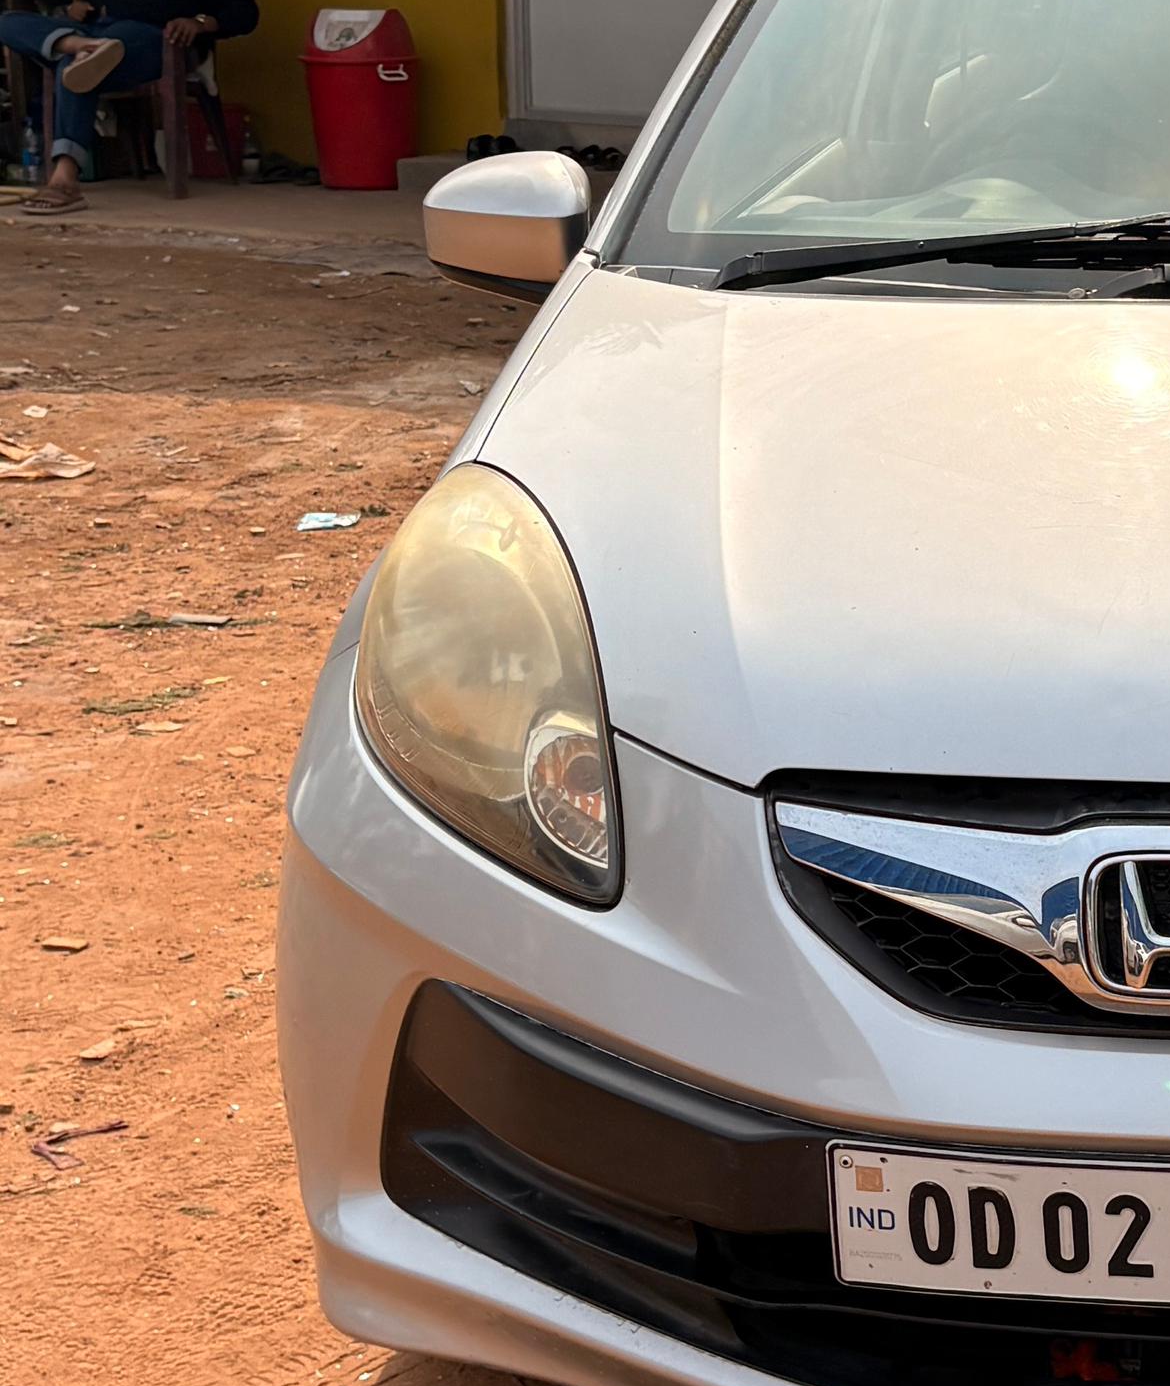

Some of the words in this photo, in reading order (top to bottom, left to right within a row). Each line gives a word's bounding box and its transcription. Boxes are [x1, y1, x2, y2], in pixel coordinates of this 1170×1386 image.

[848, 1205, 896, 1232] IND
[908, 1180, 1017, 1270] OD
[1042, 1194, 1155, 1279] 02
